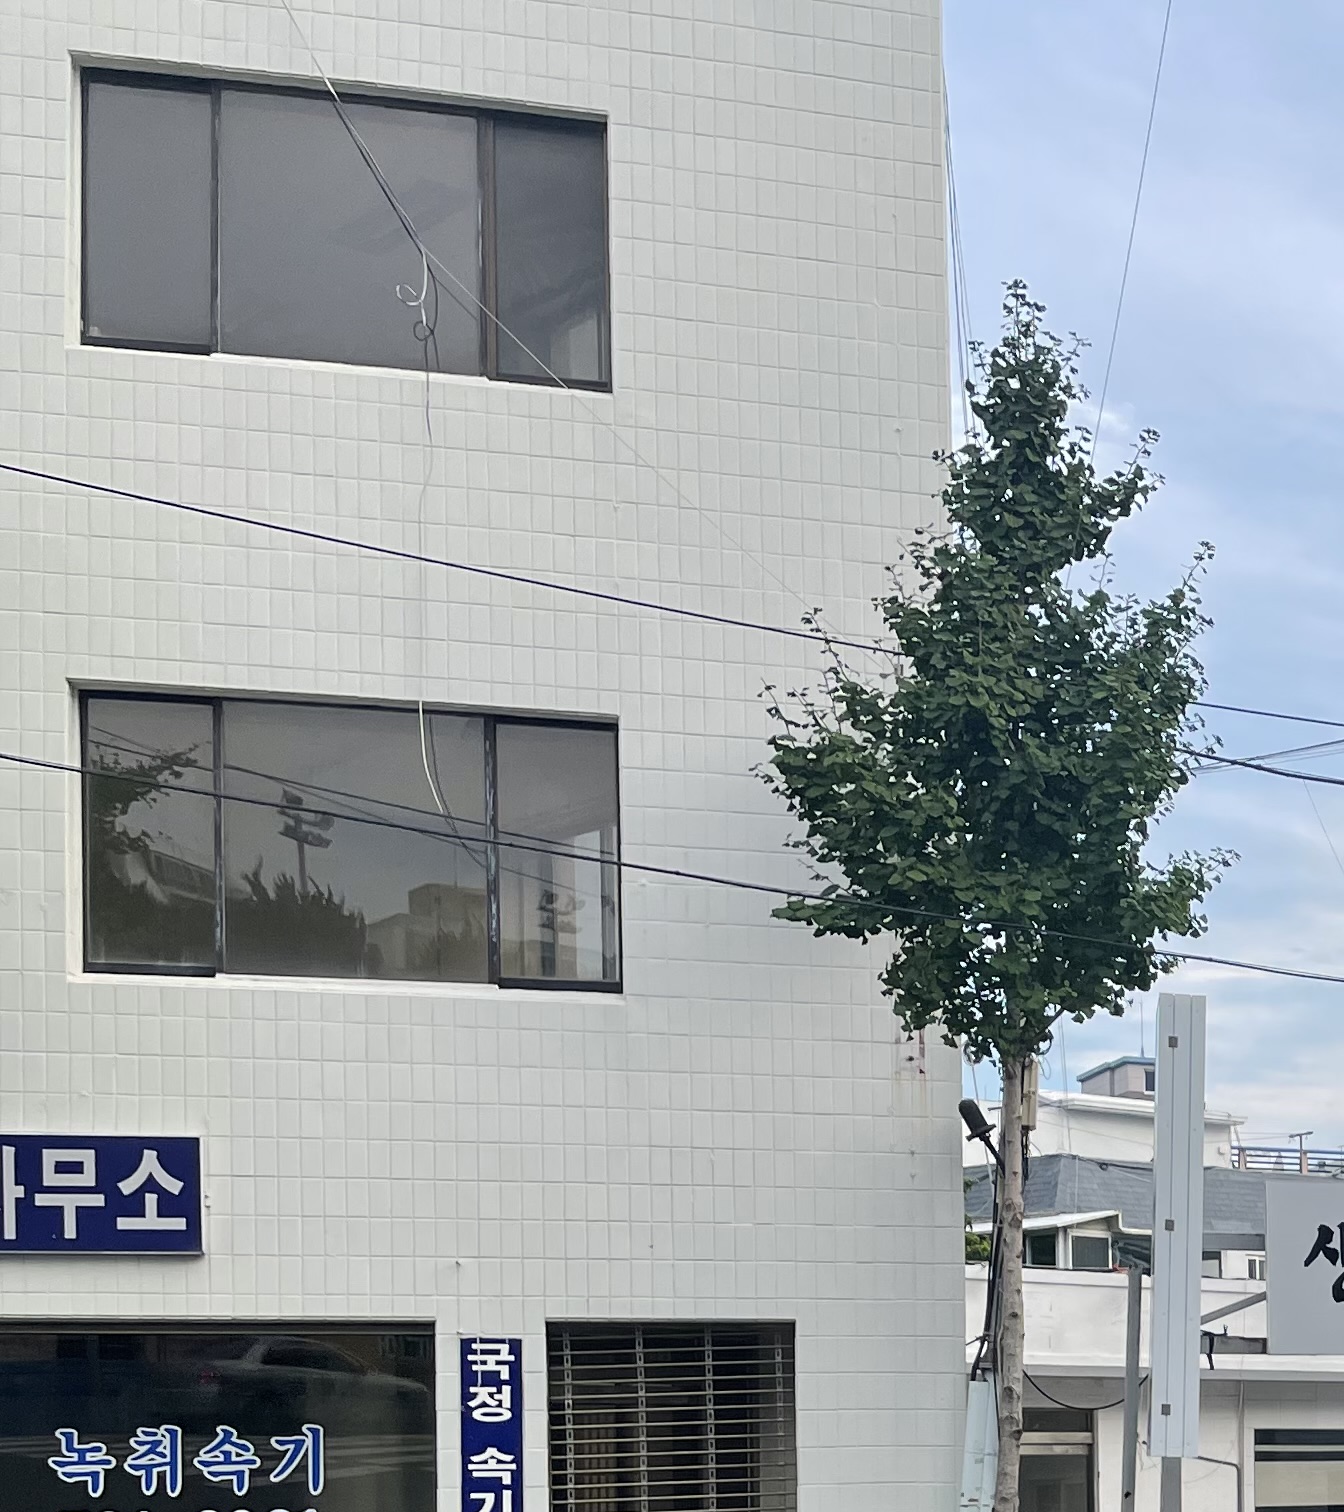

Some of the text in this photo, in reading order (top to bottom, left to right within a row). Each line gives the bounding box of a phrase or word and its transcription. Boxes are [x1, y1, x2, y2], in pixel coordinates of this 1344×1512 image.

[0, 1146, 187, 1241] 무소
[466, 1342, 515, 1422] 국정
[49, 1424, 326, 1496] 녹취속기
